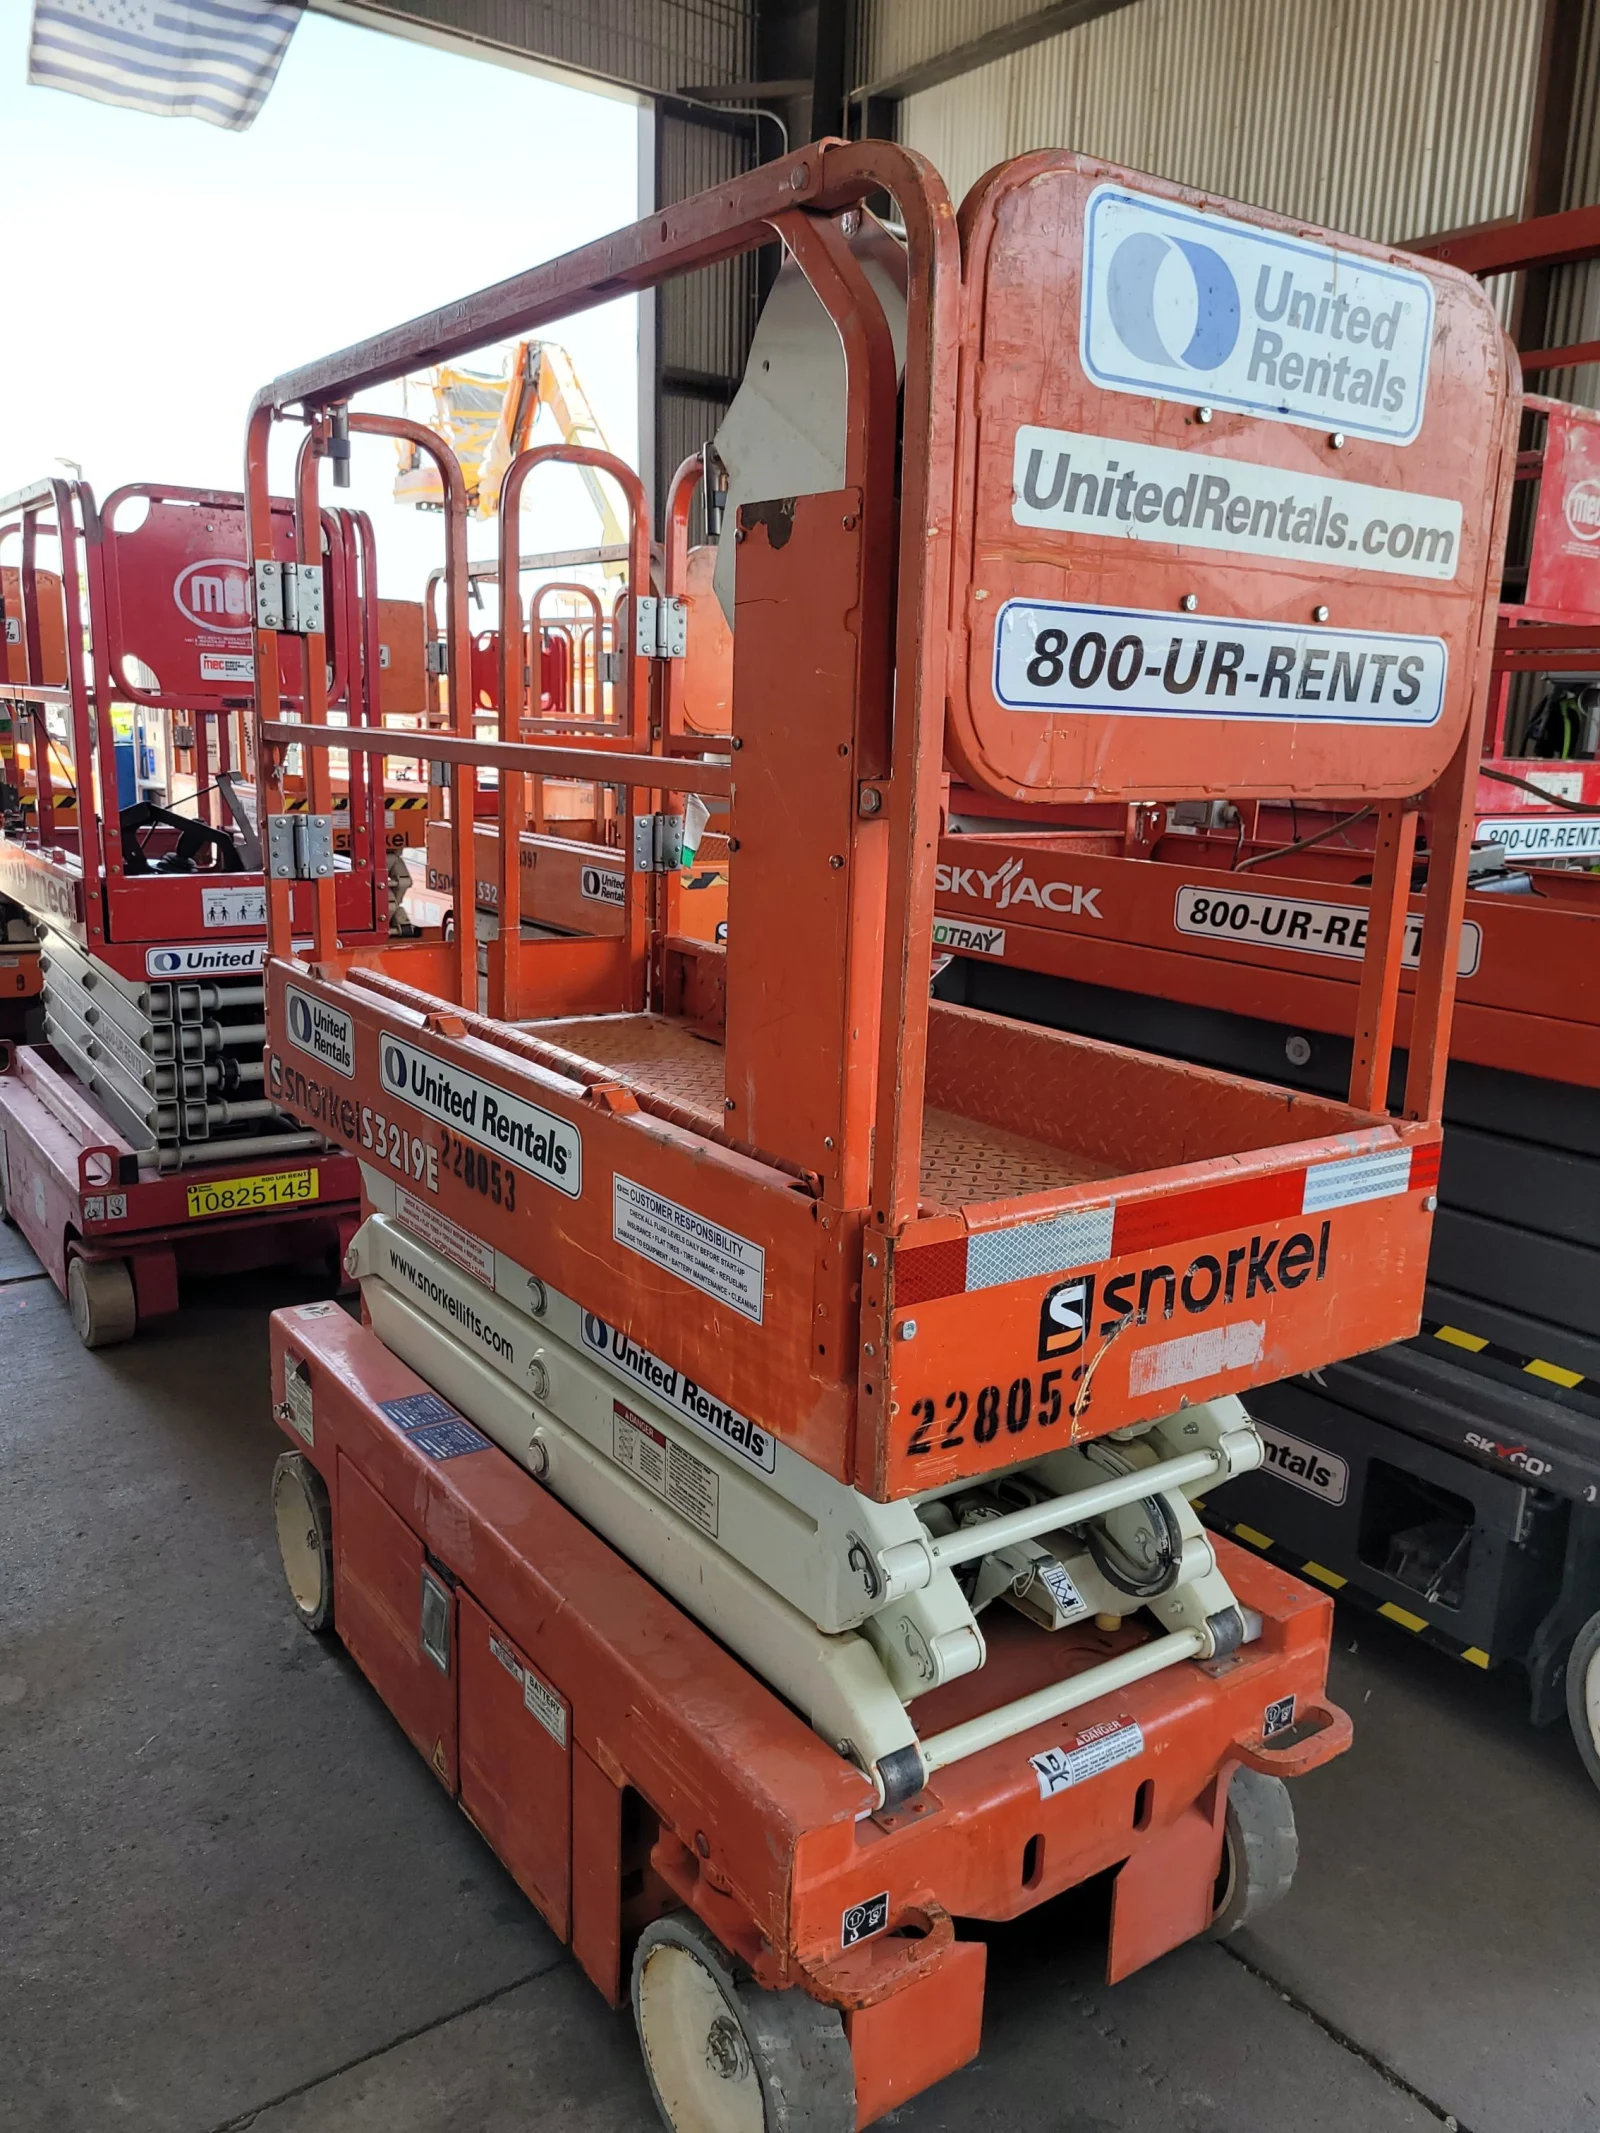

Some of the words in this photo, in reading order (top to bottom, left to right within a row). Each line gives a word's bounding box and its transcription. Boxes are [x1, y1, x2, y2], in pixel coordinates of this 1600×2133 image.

[1254, 265, 1403, 351] United
[1247, 328, 1406, 412] Rentals
[1023, 449, 1454, 564] UnitedRentals.com
[204, 660, 224, 670] mec
[1026, 629, 1424, 706] 800-UR-RENTS
[520, 850, 537, 870] 397
[1490, 827, 1600, 848] 800-UR-RENT
[478, 881, 498, 903] S32
[601, 886, 625, 901] Rental
[935, 856, 1104, 919] SKYJACK
[932, 924, 1003, 952] OTRAY
[1189, 898, 1422, 957] 800-UR-RET
[186, 950, 255, 969] United
[313, 1007, 347, 1043] United
[314, 1030, 351, 1067] Rentals
[284, 1066, 361, 1143] snorkel
[361, 1106, 439, 1194] S3219E
[411, 1060, 477, 1125] United
[482, 1095, 567, 1175] Rentals
[191, 1180, 311, 1213] 10825145
[440, 1129, 516, 1212] 228053
[630, 1189, 672, 1221] CUSTOMER
[674, 1210, 743, 1257] RESPONSIBILITY
[630, 1209, 644, 1222] CHECK
[645, 1216, 653, 1226] ALL
[654, 1221, 667, 1234] FLUID
[668, 1229, 685, 1244] LEVELS
[686, 1238, 699, 1251] DAILY
[700, 1247, 720, 1262] BEFORE
[721, 1258, 745, 1276] START-UP
[618, 1228, 636, 1243] DAMAGE
[636, 1238, 642, 1247] TO
[643, 1241, 668, 1261] EQUIPMENT
[671, 1258, 692, 1274] BATTERY
[693, 1269, 728, 1295] MAINTENANCE
[731, 1292, 757, 1313] CLEANING
[627, 1221, 651, 1239] INSURANCE
[655, 1236, 666, 1248] FLAT
[667, 1242, 680, 1255] TIRES
[683, 1250, 694, 1263] TIRE
[695, 1257, 716, 1274] DAMAGE
[719, 1271, 748, 1293] REFUELING
[1100, 1220, 1331, 1337] snorkel
[390, 1249, 514, 1364] www.snorkellifts.com
[612, 1329, 678, 1397] United
[682, 1376, 765, 1457] Rentals
[629, 1412, 654, 1438] DANGER
[1263, 1440, 1331, 1487] ntals
[529, 1675, 560, 1715] BATTERY
[1082, 1720, 1122, 1743] DANGER
